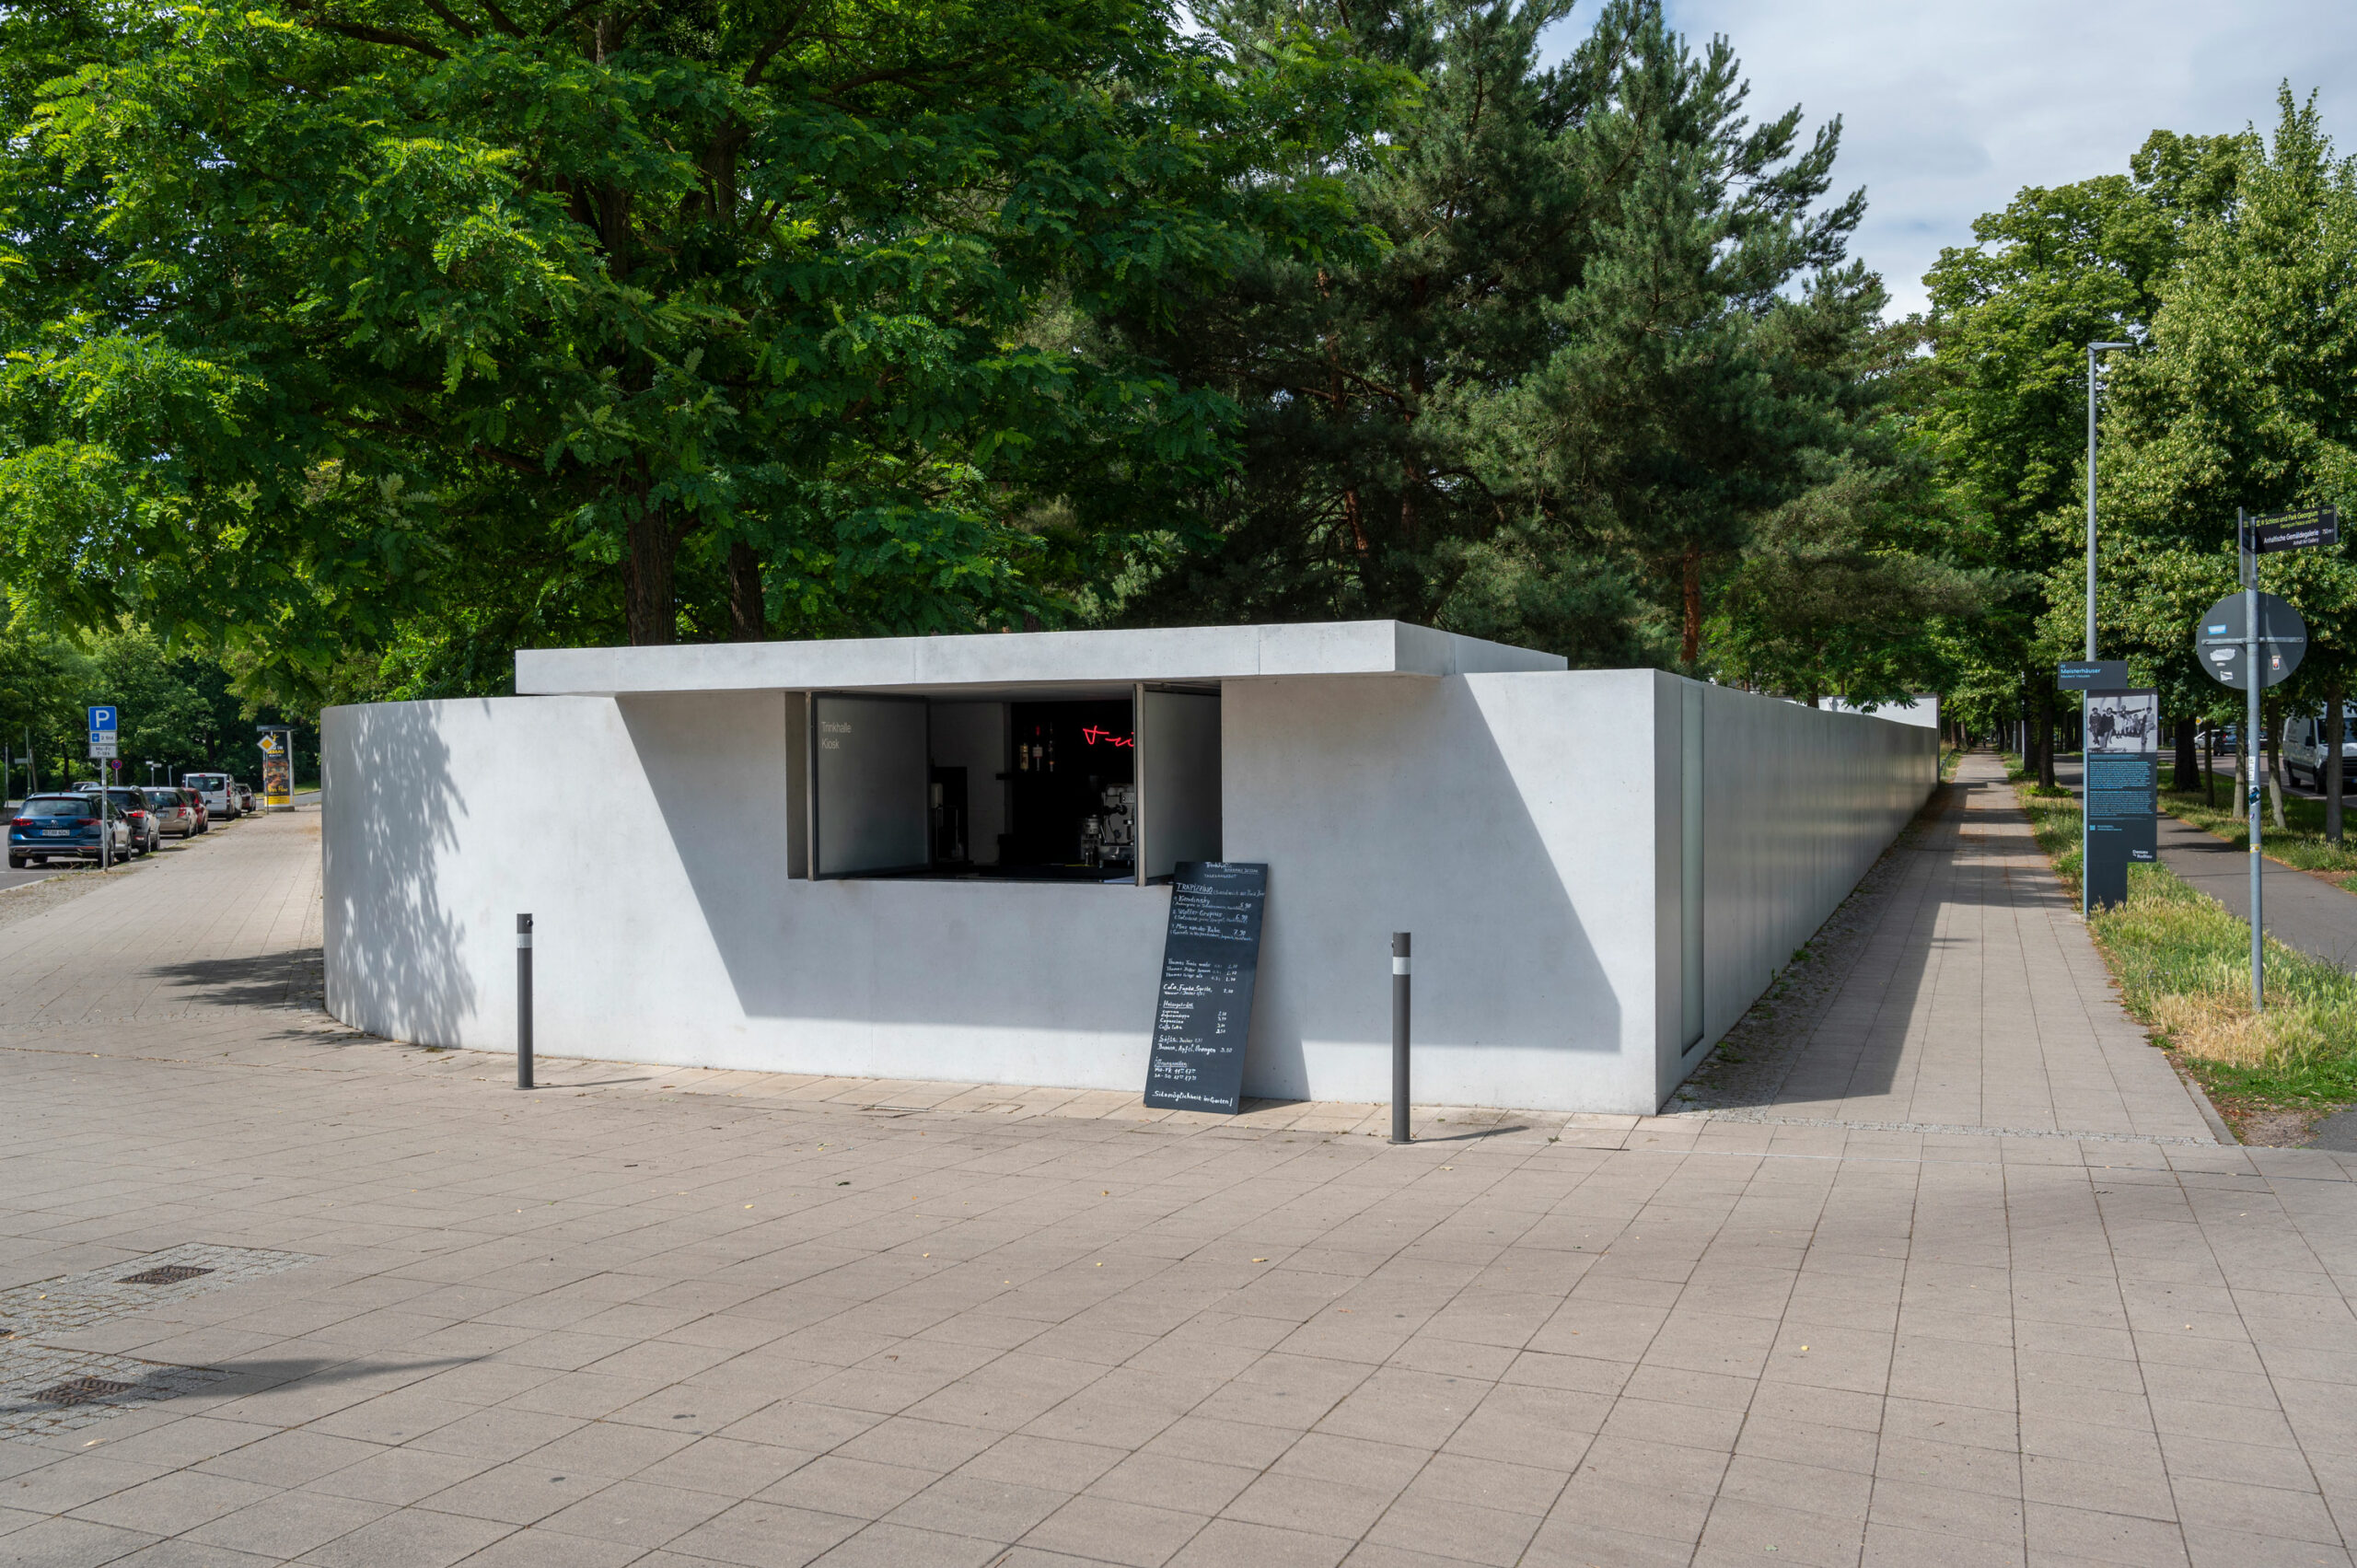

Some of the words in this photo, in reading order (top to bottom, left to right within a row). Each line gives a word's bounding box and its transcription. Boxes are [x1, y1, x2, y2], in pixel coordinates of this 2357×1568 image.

[2265, 517, 2279, 526] Schloss
[2297, 510, 2318, 519] Georgium
[96, 710, 110, 728] P
[821, 721, 853, 734] Trinkhalle
[821, 738, 840, 749] Kiosk
